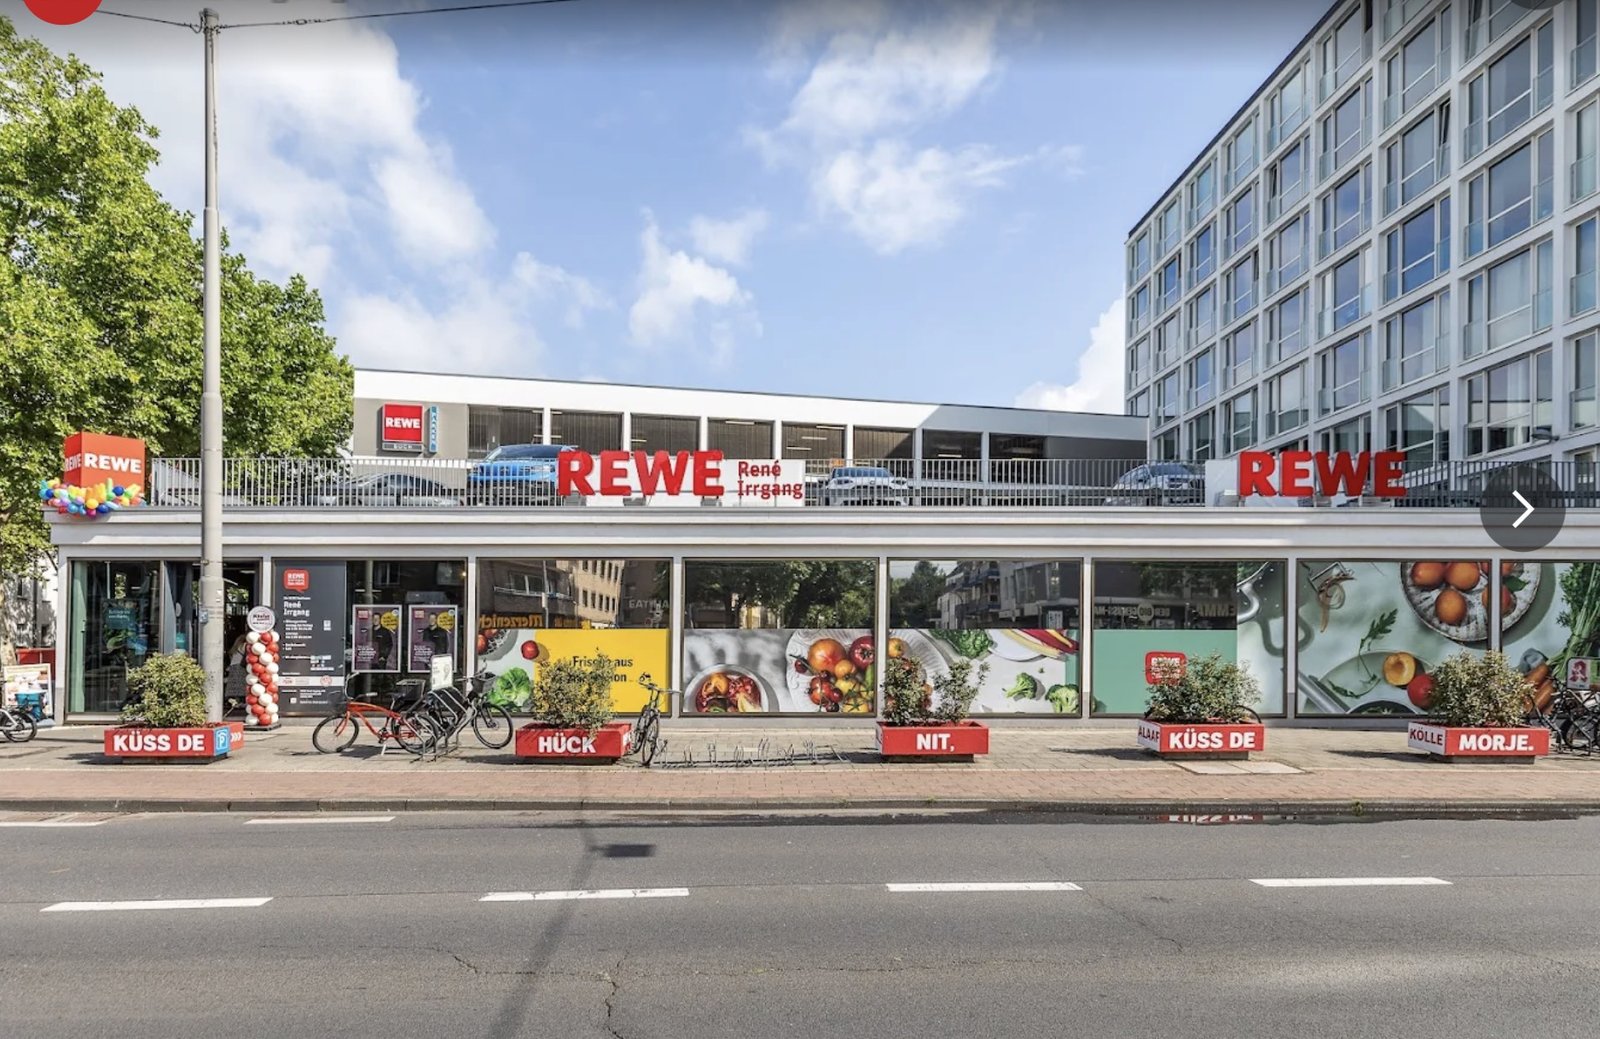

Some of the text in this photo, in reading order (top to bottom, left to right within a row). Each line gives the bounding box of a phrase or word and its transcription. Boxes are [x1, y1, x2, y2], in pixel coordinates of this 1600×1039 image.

[386, 417, 420, 429] REWE
[84, 453, 142, 474] REWE
[738, 460, 781, 477] René
[558, 450, 724, 497] REWE
[1239, 451, 1407, 497] REWE
[737, 480, 803, 499] Irrgang
[283, 601, 301, 609] René
[283, 608, 310, 617] Irrgang
[614, 658, 633, 667] aus
[113, 731, 205, 751] KÜSS DE
[538, 732, 596, 753] HÜCK
[917, 733, 955, 752] NIT,
[1138, 725, 1160, 743] ALAAF
[1169, 728, 1255, 749] KÜSS DE
[1409, 727, 1443, 746] KÖLLE
[1459, 734, 1534, 751] MORJE.
